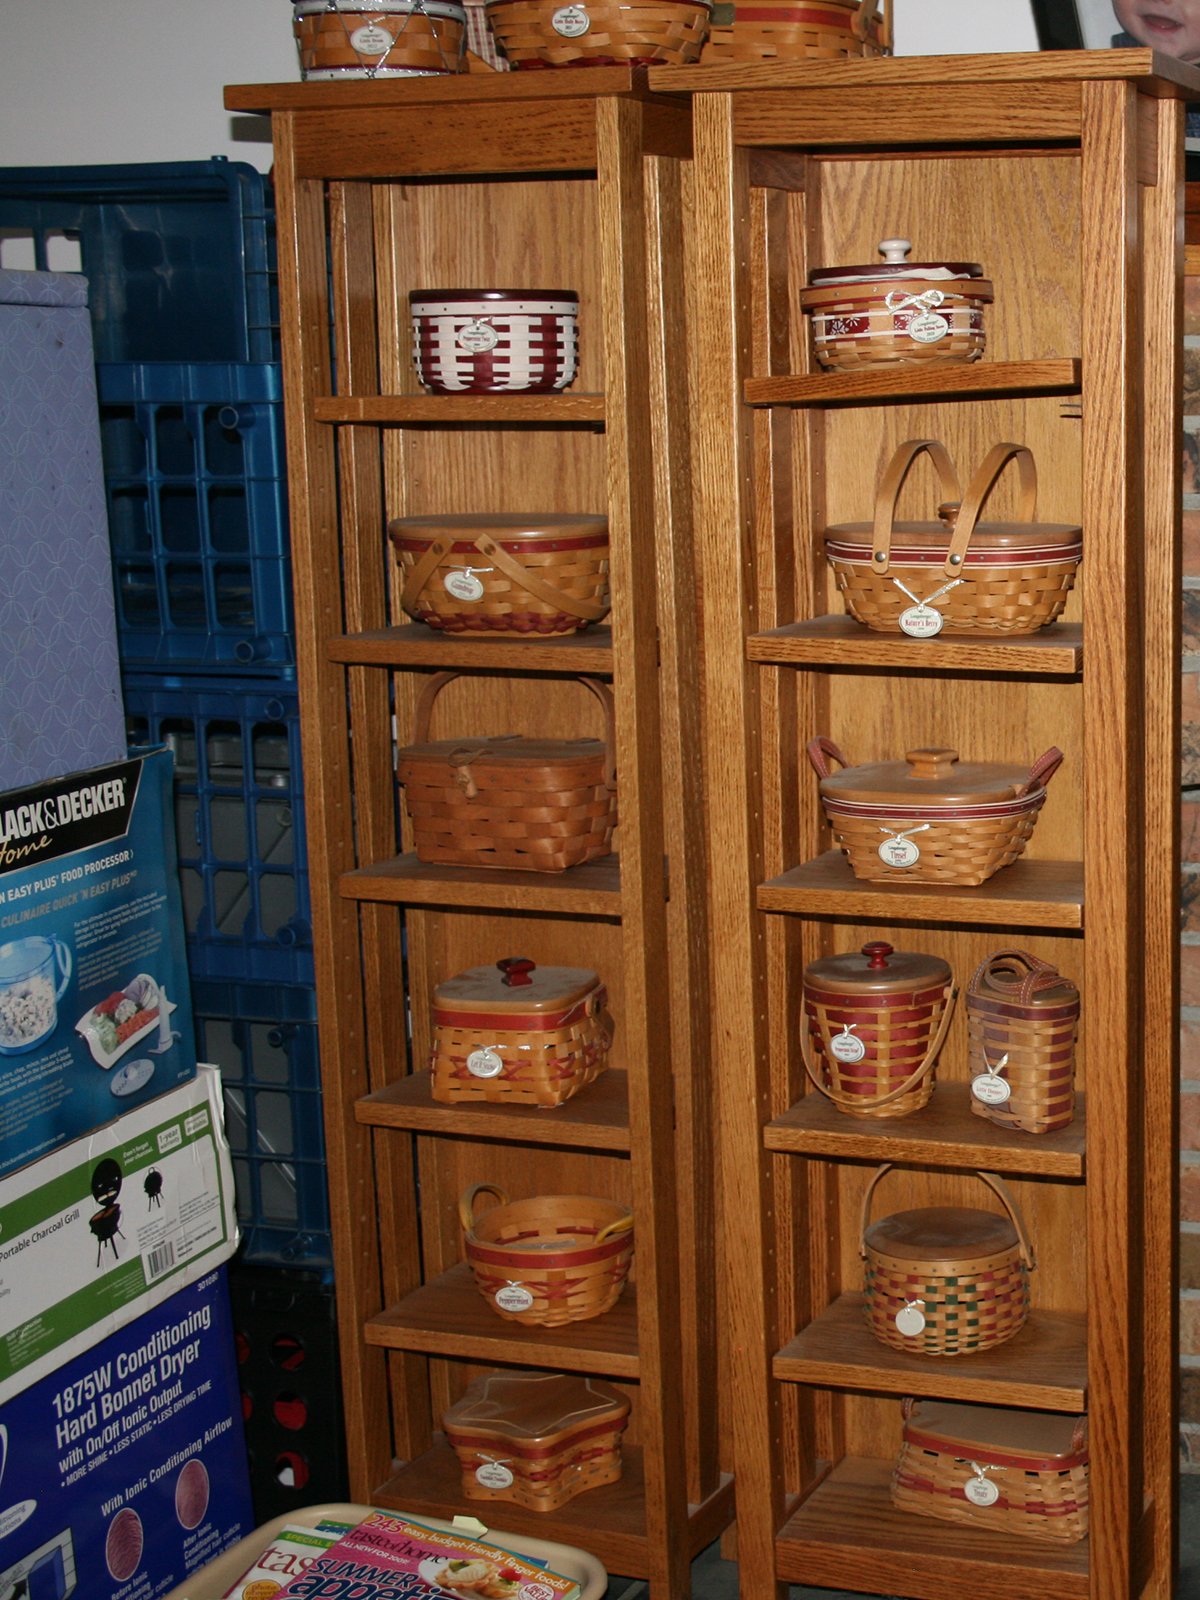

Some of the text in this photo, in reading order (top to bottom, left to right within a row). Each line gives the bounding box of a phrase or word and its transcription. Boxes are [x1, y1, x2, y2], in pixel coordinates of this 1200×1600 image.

[8, 884, 33, 902] EASY
[61, 866, 83, 884] FOOD
[84, 850, 130, 878] PROCESSOR
[1, 902, 51, 928] CULINAIRE
[54, 892, 78, 910] QUICK
[90, 881, 111, 898] EASY
[159, 1128, 179, 1143] 1-year
[0, 1208, 80, 1262] Portable Charcoal Grill
[52, 1362, 112, 1419] 1875W
[116, 1304, 212, 1379] Conditioning
[55, 1339, 200, 1449] Hard Bonnet Dryer
[59, 1380, 183, 1473] with On/Off Ionic Output
[66, 1380, 212, 1487] MORE SHINE LESS STATIC LESS DRYING TIME
[101, 1417, 233, 1517] With Ionic Conditioning Airflow
[183, 1534, 197, 1549] After
[184, 1529, 220, 1560] Conditioning
[285, 1532, 322, 1547] SPECIAL
[340, 1541, 355, 1550] ALL
[354, 1544, 374, 1555] NEW
[373, 1548, 390, 1559] FOR
[364, 1513, 410, 1534] 243
[428, 1532, 505, 1563] budget-friendly
[504, 1556, 536, 1577] finger
[534, 1571, 571, 1590] foods!
[308, 1558, 419, 1589] SUMMER
